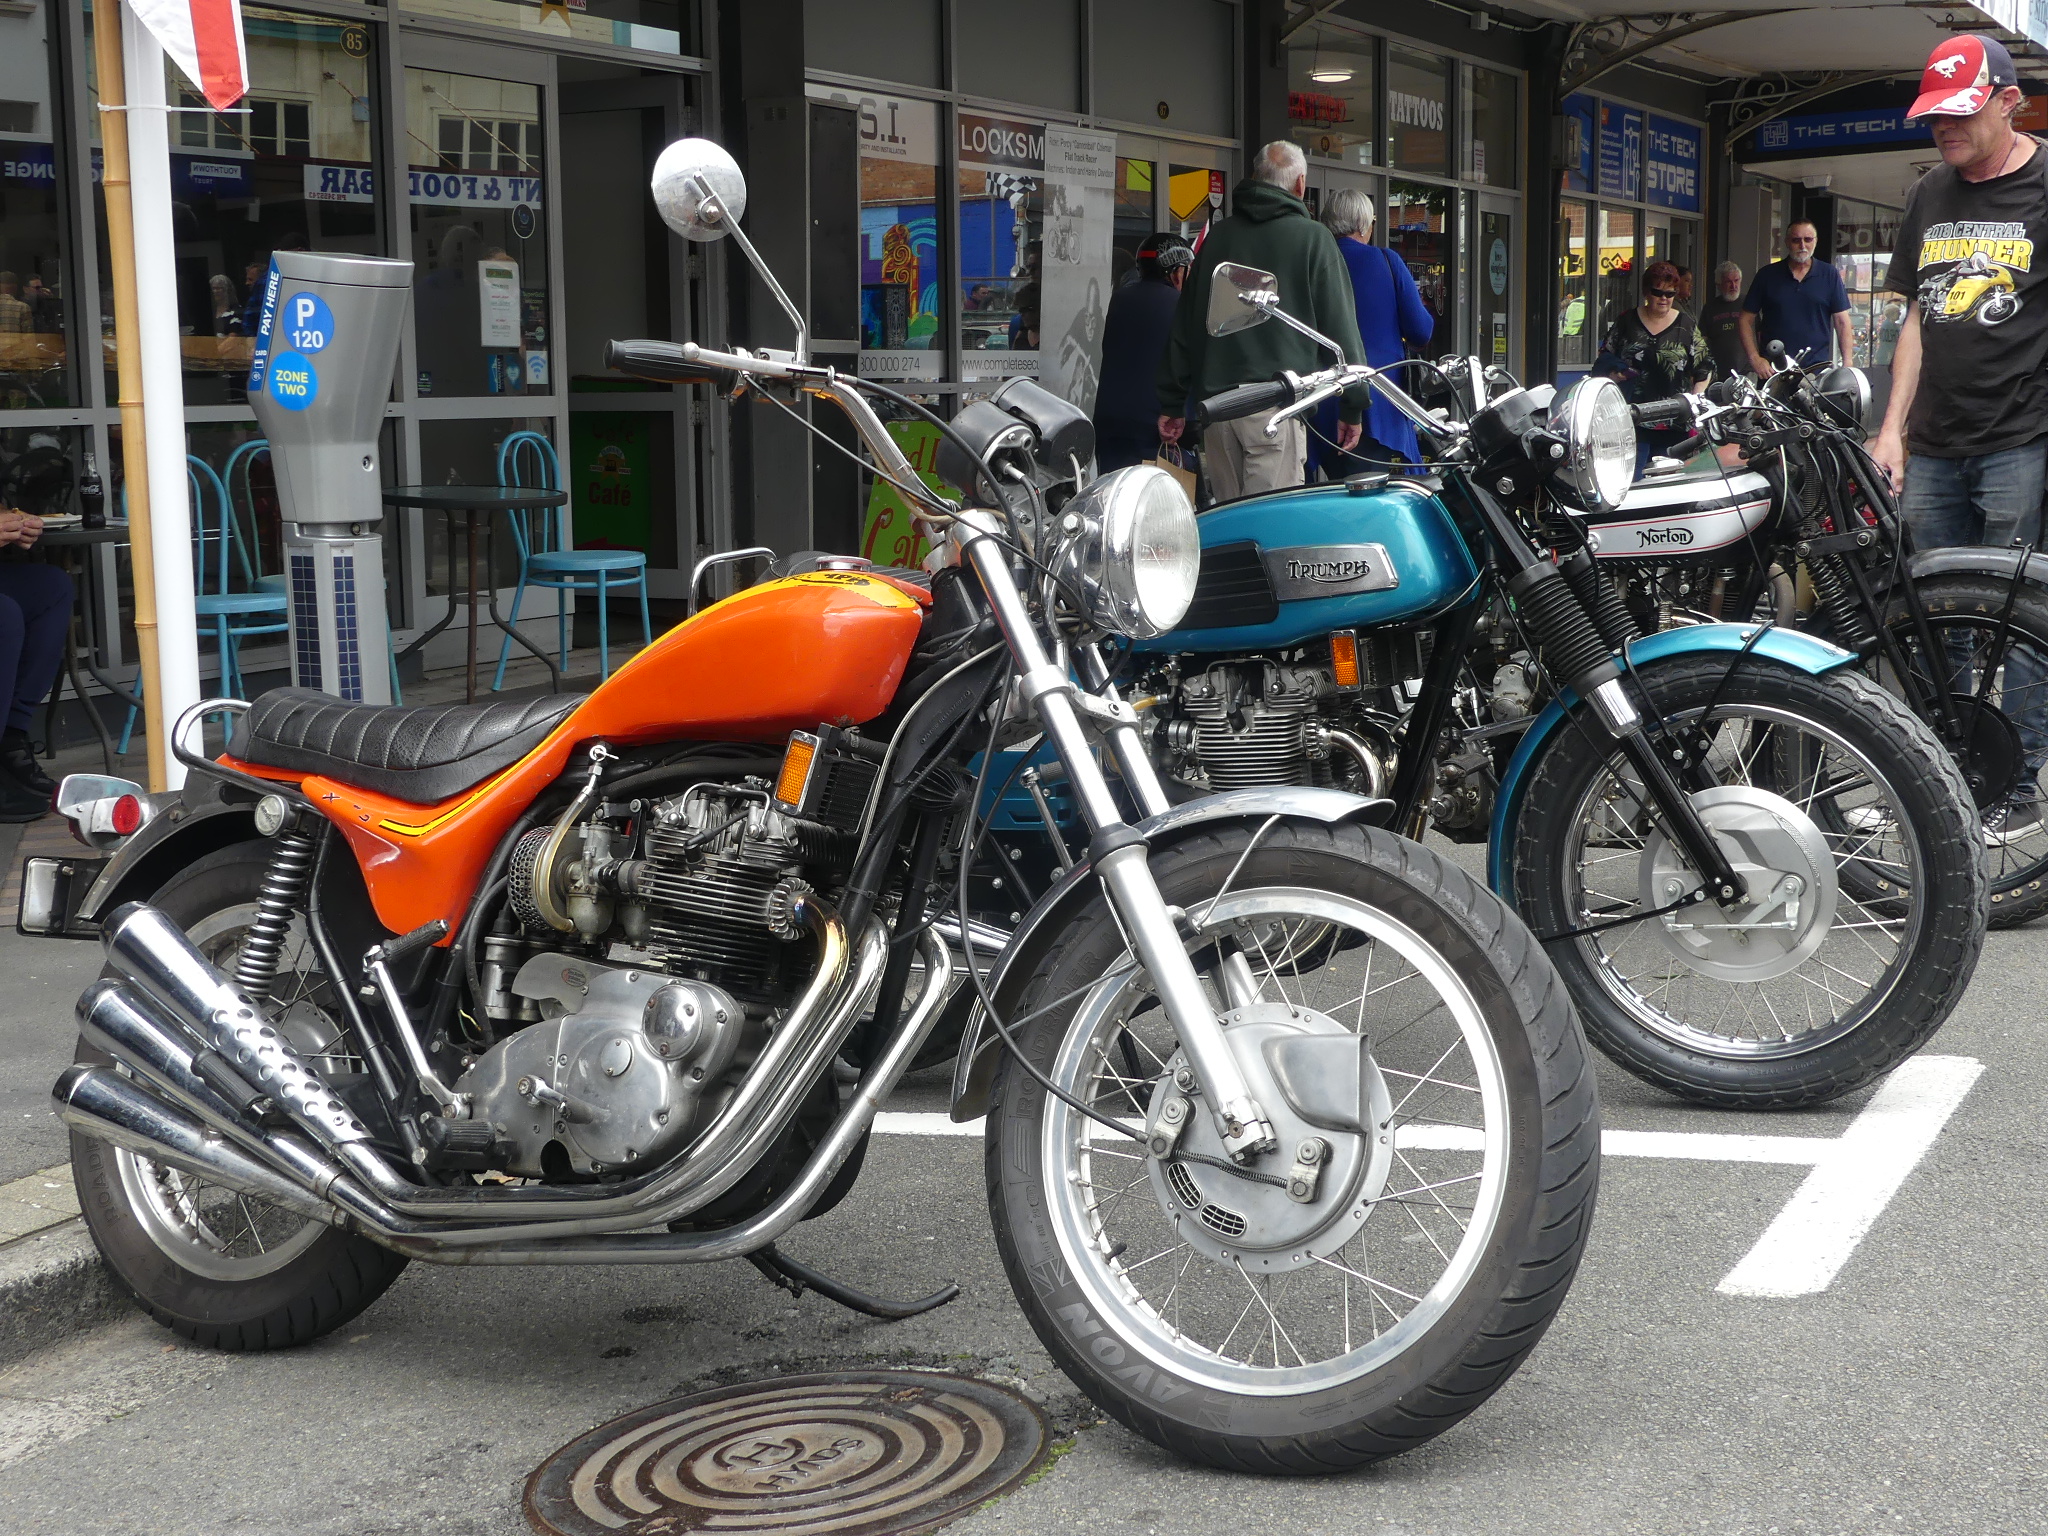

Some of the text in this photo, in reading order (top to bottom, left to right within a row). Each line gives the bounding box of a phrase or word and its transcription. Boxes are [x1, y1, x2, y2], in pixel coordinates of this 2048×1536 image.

[346, 33, 363, 51] 85
[1389, 91, 1444, 132] TATTOOS
[1794, 123, 1836, 138] THE
[1841, 118, 1896, 135] TECH
[961, 124, 1044, 161] LOCKSM
[1648, 129, 1696, 159] THE TECH
[1064, 151, 1073, 161] Flat
[1074, 152, 1085, 162] Track
[1648, 160, 1695, 197] STORE
[1923, 221, 2024, 239] 2018 CENTRAL
[260, 271, 280, 336] PAY HERE
[1950, 290, 1966, 301] 101
[297, 298, 315, 328] P
[292, 330, 324, 349] 120
[880, 356, 900, 372] 000
[901, 356, 920, 372] 274
[275, 369, 309, 384] ZONE
[278, 383, 307, 396] TWO
[588, 482, 632, 507] Café
[1636, 527, 1695, 549] Norton
[1287, 559, 1371, 584] TRIUMPH
[1885, 601, 1956, 626] EALE
[1055, 1301, 1194, 1405] AVON
